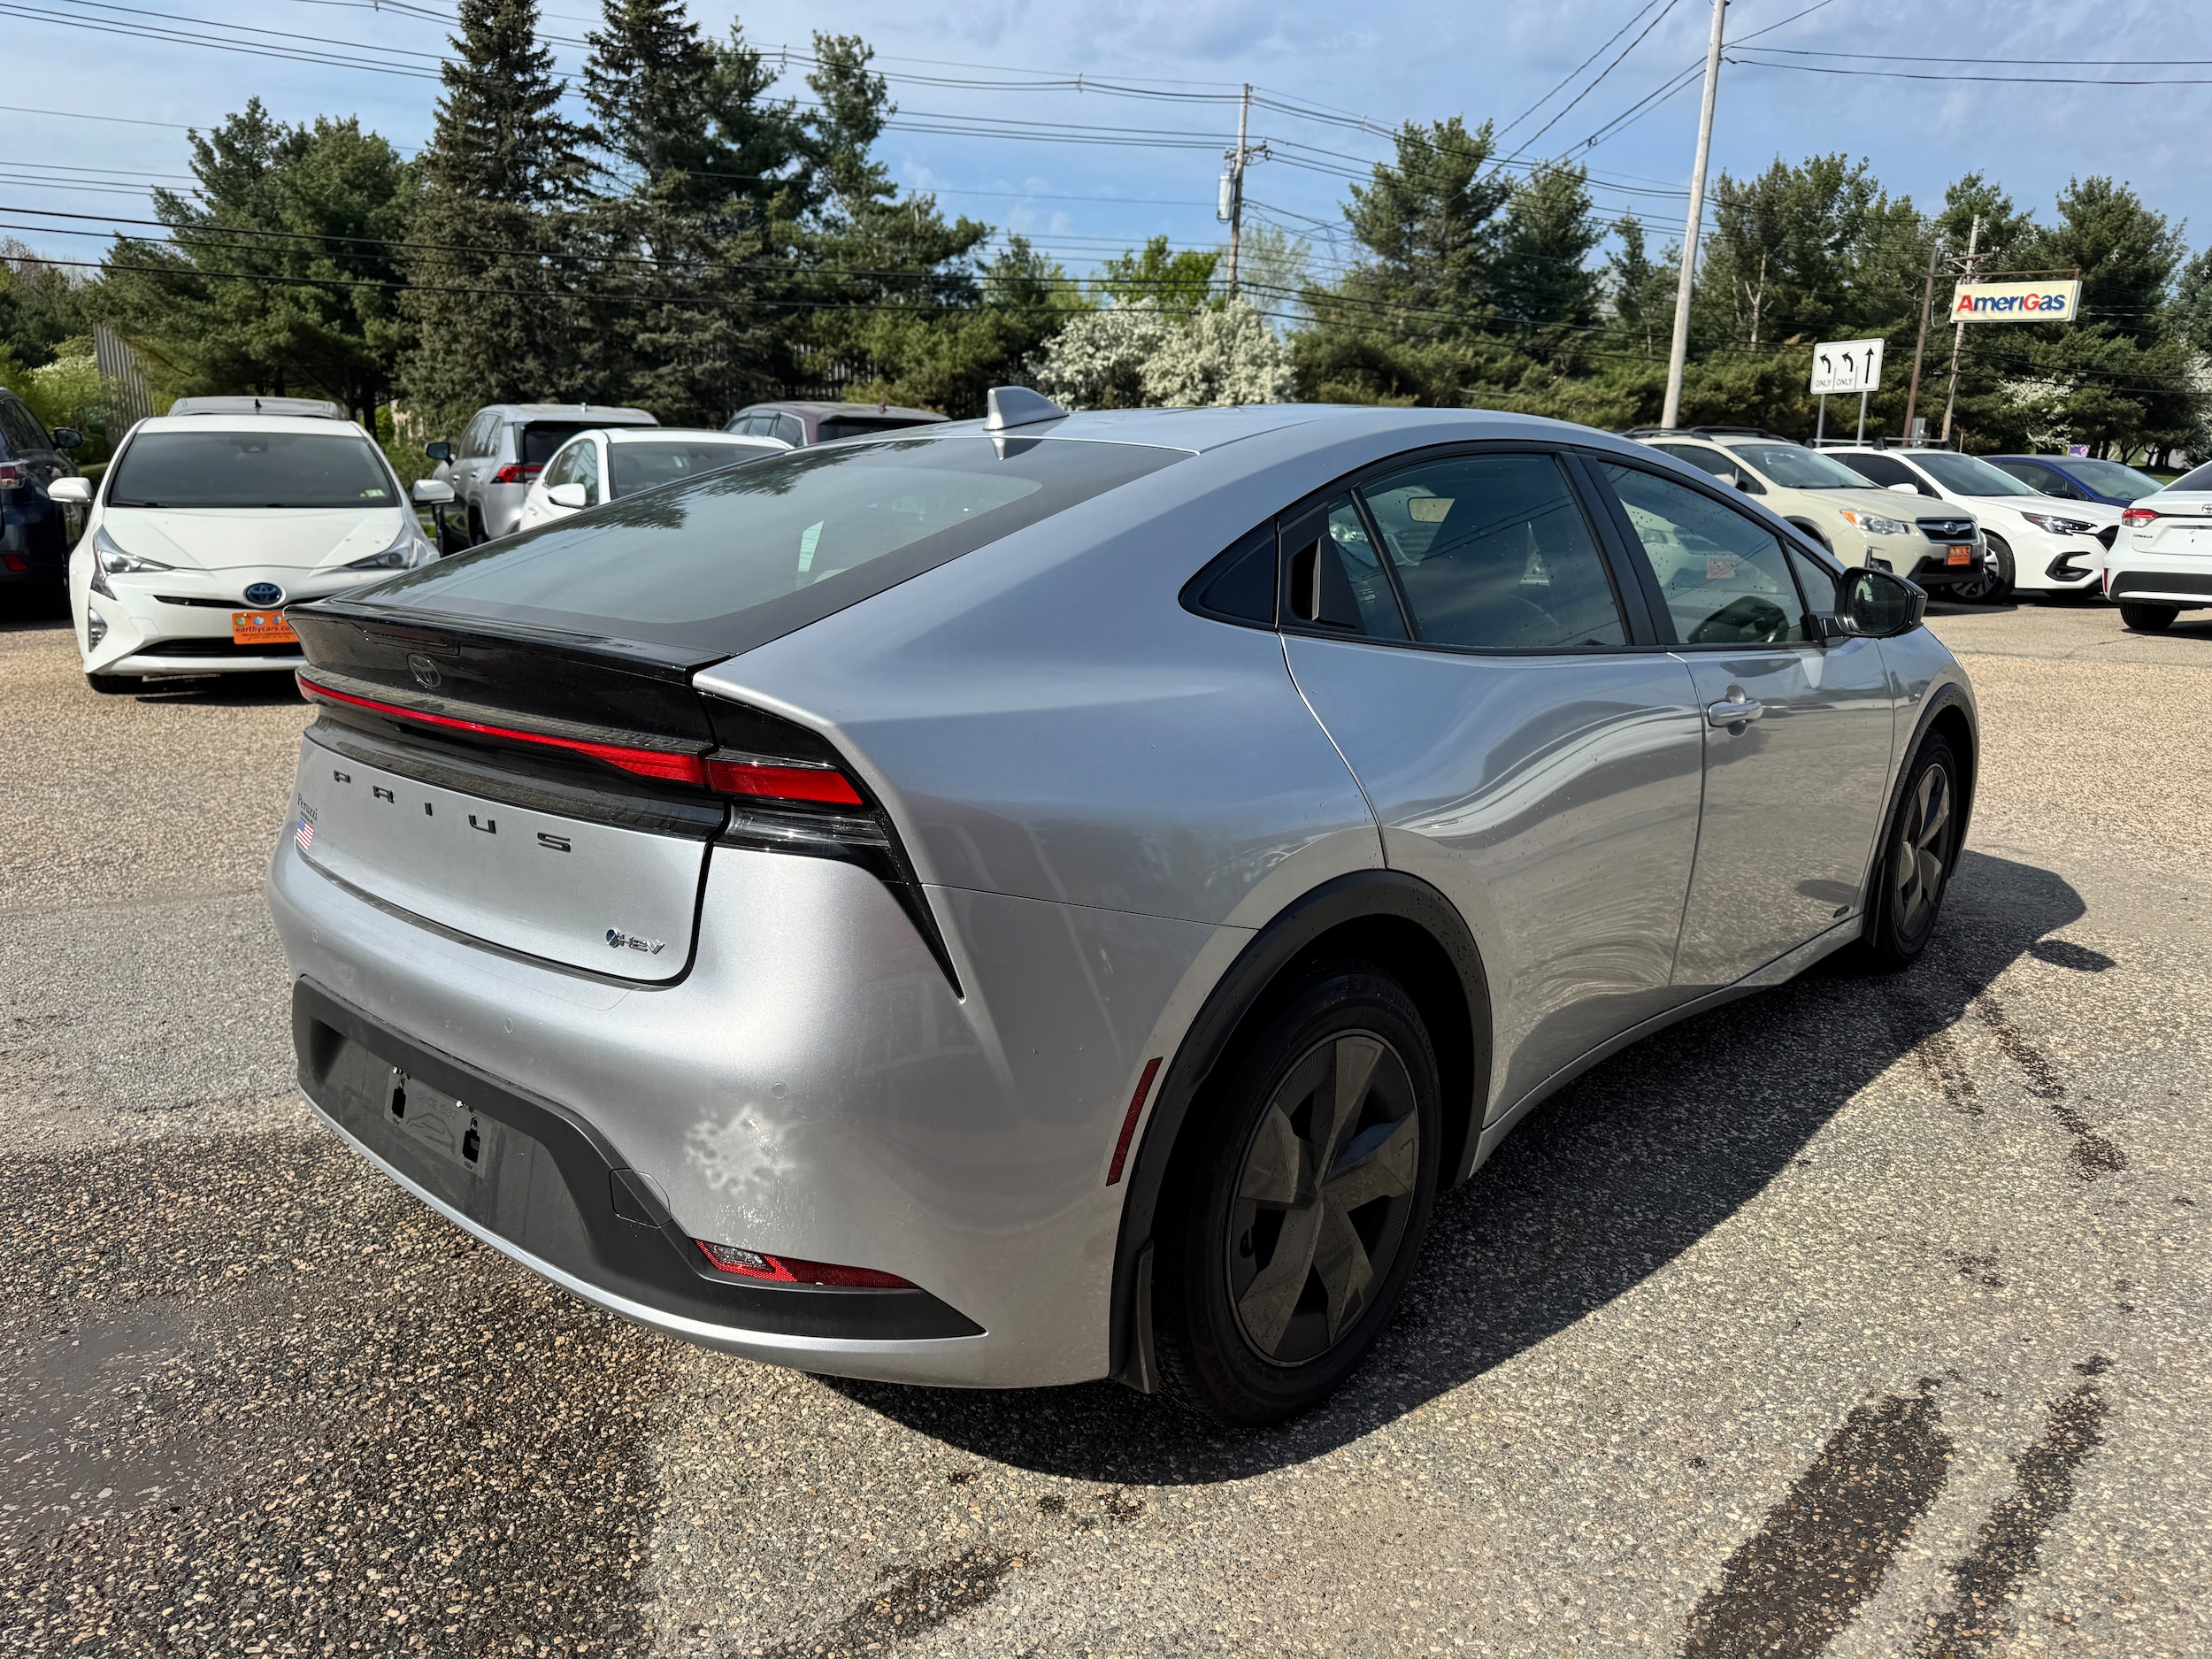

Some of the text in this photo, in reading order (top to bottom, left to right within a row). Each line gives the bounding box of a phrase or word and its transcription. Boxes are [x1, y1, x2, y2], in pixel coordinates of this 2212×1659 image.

[1955, 293, 2066, 312] AmeriGas
[1815, 379, 1832, 388] ONLY
[1836, 377, 1854, 387] ONLY
[297, 792, 318, 821] Peruzzi
[333, 769, 572, 853] PRIUS
[619, 934, 665, 956] HEV
